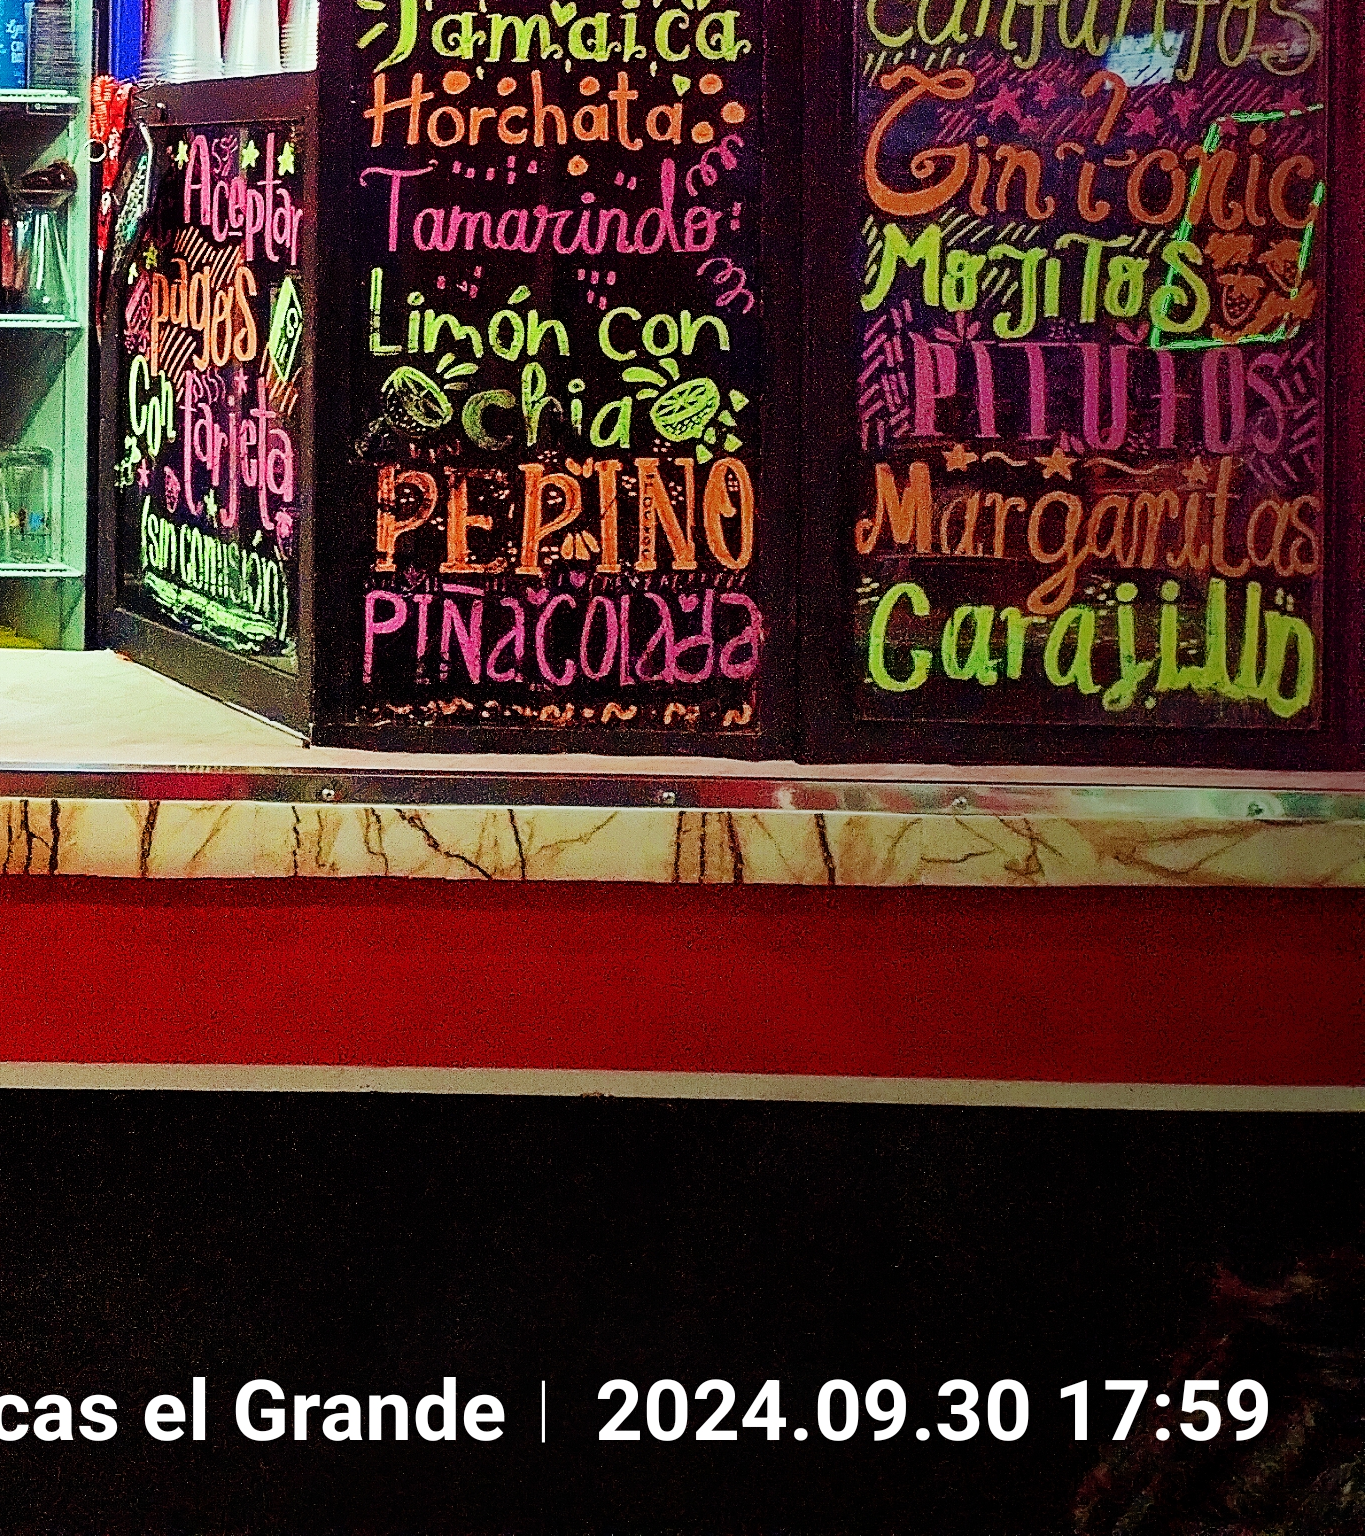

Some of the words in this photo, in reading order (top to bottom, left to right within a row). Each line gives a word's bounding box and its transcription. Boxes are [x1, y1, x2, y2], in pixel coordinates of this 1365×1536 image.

[364, 69, 683, 151] Horchata
[359, 158, 719, 254] Tamarindo
[369, 267, 570, 361] Limón
[598, 307, 731, 361] con
[461, 361, 633, 450] chia
[375, 456, 755, 575] PEPINO
